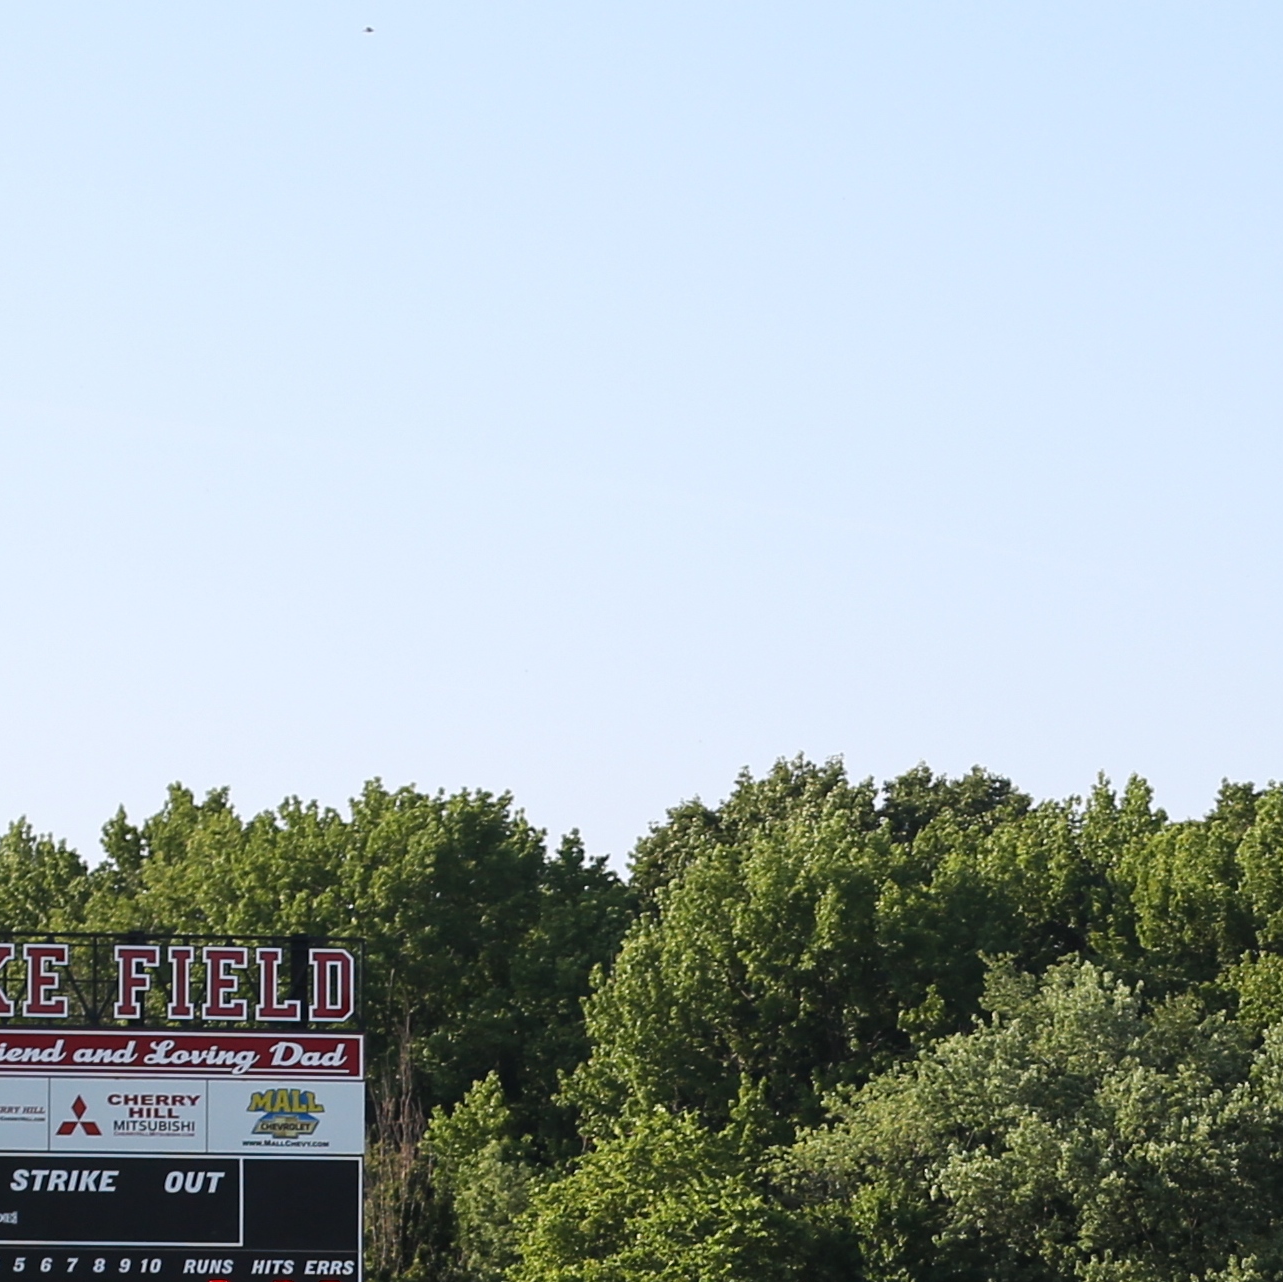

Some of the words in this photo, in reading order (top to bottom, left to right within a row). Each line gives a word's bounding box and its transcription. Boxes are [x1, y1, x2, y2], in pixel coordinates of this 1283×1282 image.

[114, 944, 356, 1022] FIELD
[72, 1041, 138, 1065] and
[142, 1041, 260, 1074] Loving
[269, 1043, 348, 1068] Dad
[107, 1093, 201, 1106] CHERRY
[247, 1089, 325, 1113] MALL
[21, 1106, 46, 1115] HILL
[129, 1107, 180, 1119] HILL
[113, 1120, 195, 1132] MITSUBISHI
[261, 1122, 311, 1131] CHEVROLET
[10, 1169, 118, 1193] STRIKE
[164, 1171, 224, 1194] OUT
[13, 1256, 26, 1272] 5
[39, 1256, 52, 1272] 6
[66, 1257, 78, 1273] 7
[92, 1257, 106, 1273] 8
[119, 1257, 131, 1273] 9
[140, 1257, 162, 1273] 10
[183, 1259, 234, 1275] RUNS
[251, 1259, 295, 1275] HITS
[304, 1260, 354, 1275] ERRS
